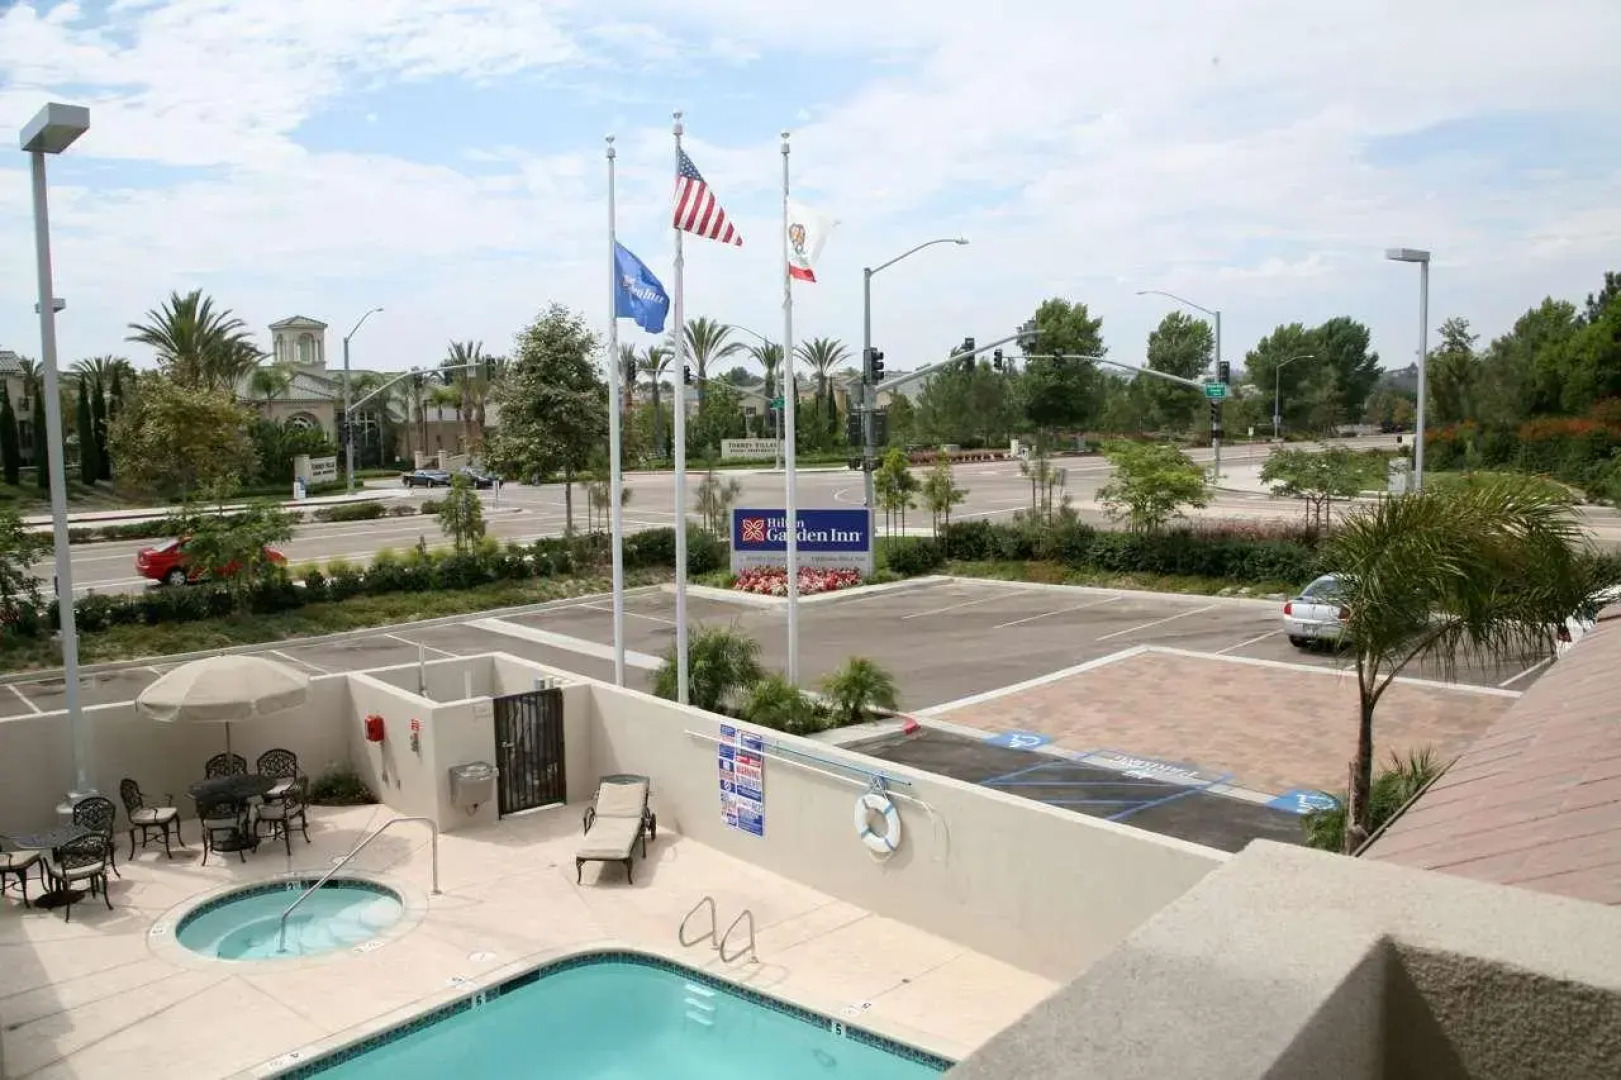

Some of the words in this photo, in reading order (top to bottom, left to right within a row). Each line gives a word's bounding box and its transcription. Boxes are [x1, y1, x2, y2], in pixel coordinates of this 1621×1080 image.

[767, 517, 805, 528] Hiln
[766, 528, 828, 542] Gaden
[831, 528, 861, 542] Inn
